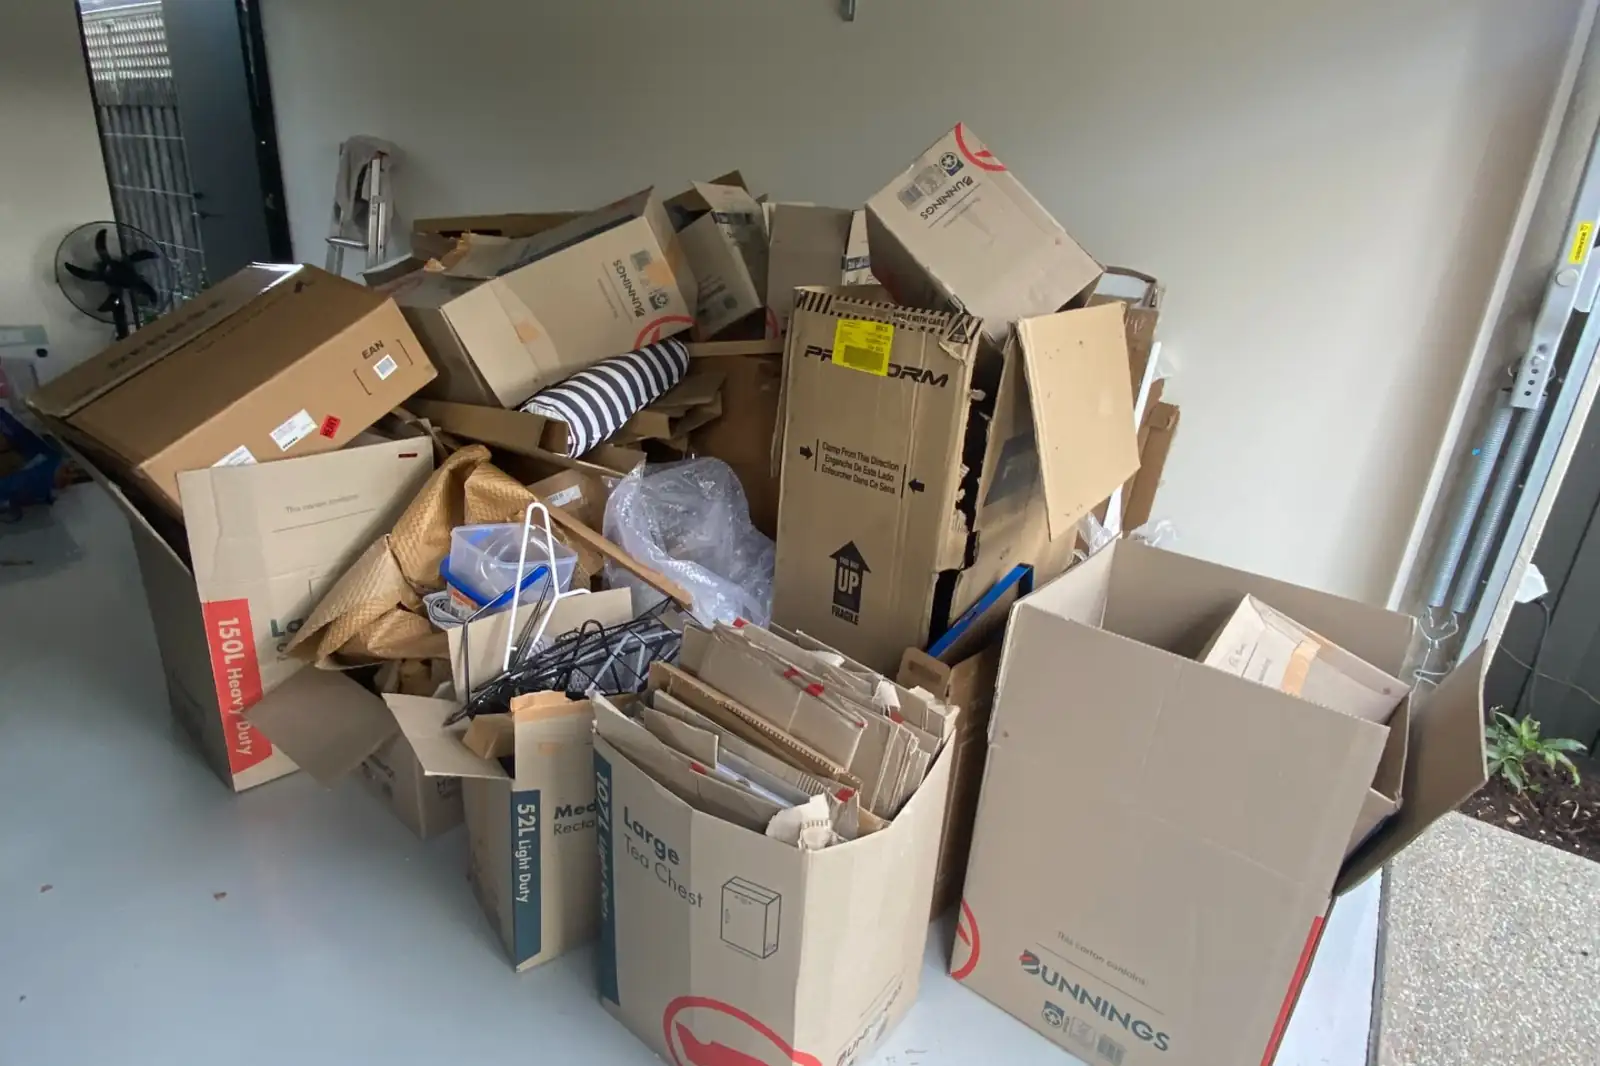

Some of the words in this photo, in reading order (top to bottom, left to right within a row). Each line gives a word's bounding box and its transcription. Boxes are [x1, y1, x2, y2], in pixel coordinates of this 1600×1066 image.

[919, 174, 975, 221] BUNNINGS
[614, 258, 645, 318] BUNNINGS
[361, 340, 385, 360] EAN
[804, 345, 949, 388] PRORM
[837, 566, 859, 595] UP
[832, 604, 859, 626] FRAGILE
[217, 617, 245, 664] 150L
[226, 668, 243, 716] Heavy
[235, 719, 253, 756] Duty
[516, 803, 536, 837] 52L
[595, 771, 610, 833] 107L
[514, 839, 531, 870] Light
[623, 805, 680, 866] Large
[515, 872, 531, 903] Duty
[623, 832, 650, 870] Tea
[653, 861, 703, 908] Chest
[1019, 948, 1171, 1053] BUNNINGS
